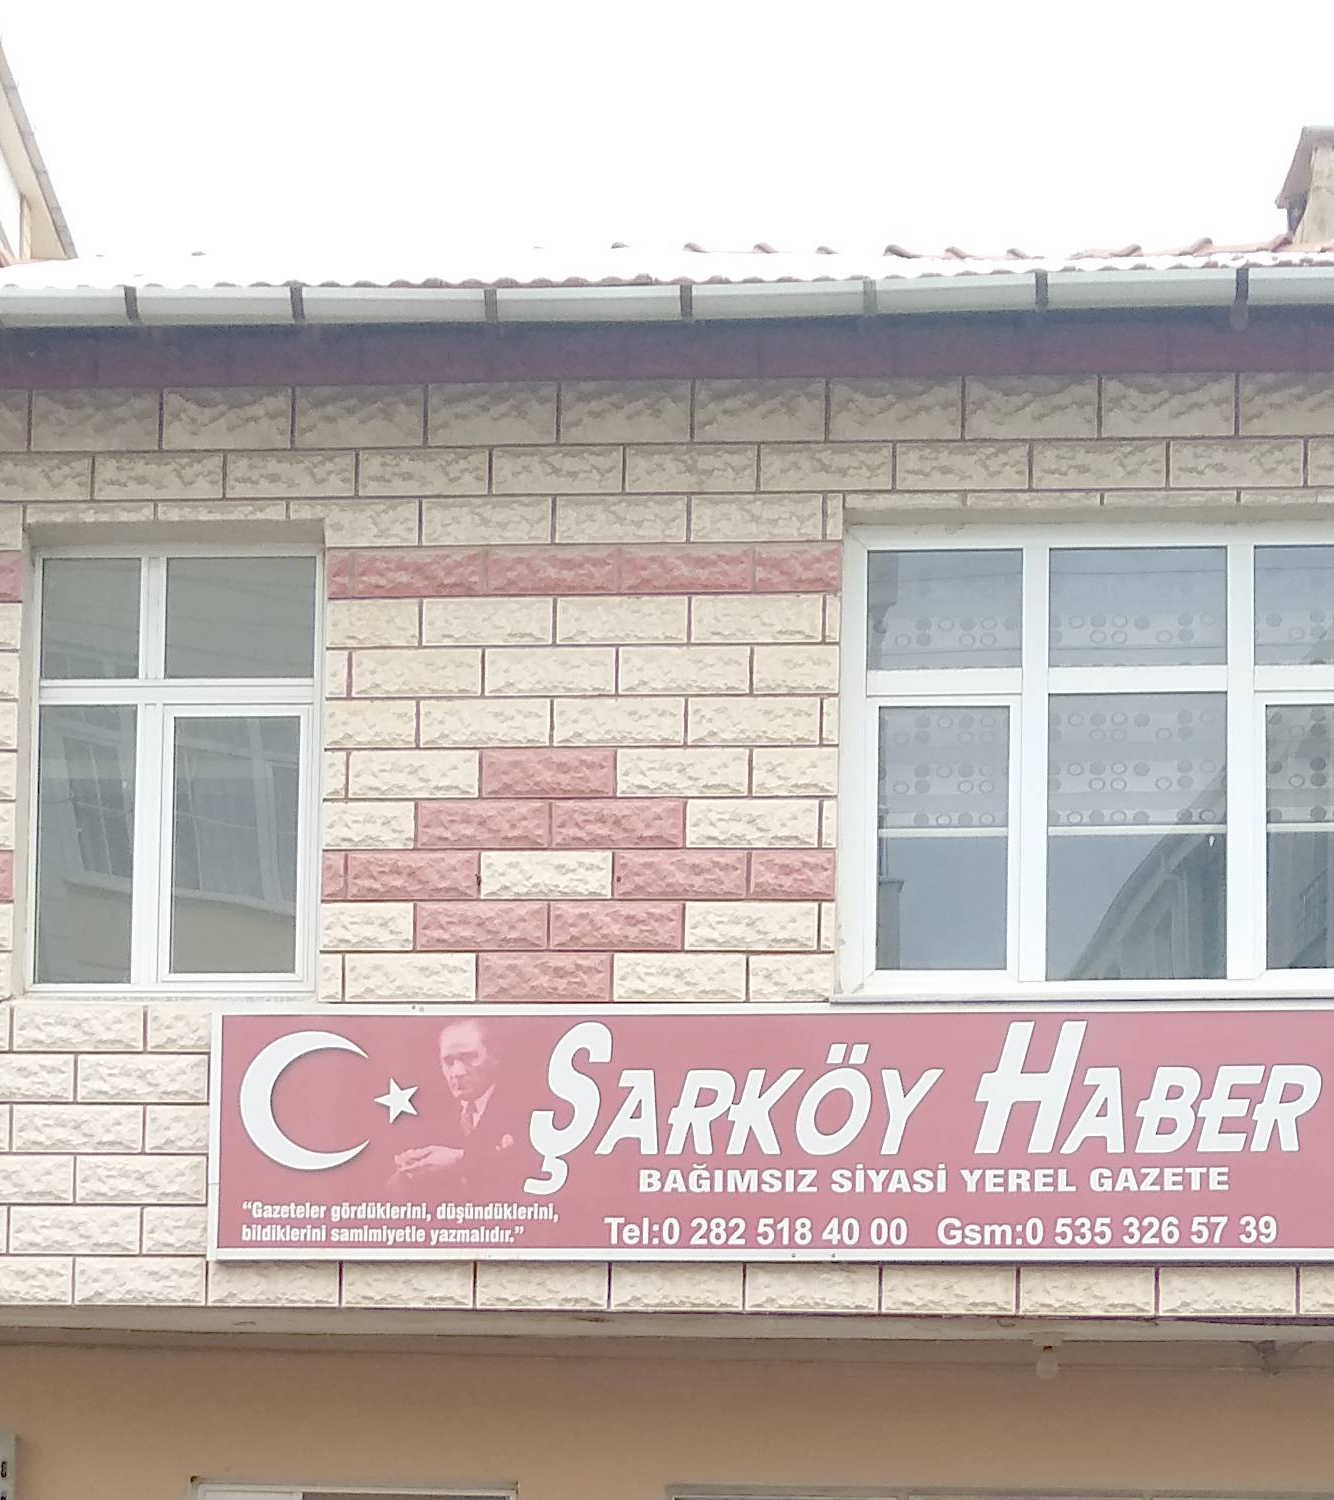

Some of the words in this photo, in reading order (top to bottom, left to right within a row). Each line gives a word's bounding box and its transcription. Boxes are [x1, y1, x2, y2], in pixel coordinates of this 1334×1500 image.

[523, 1021, 945, 1195] ŞARKÖY
[973, 1020, 1323, 1155] HABER
[638, 1163, 819, 1193] BAĞIMSIZ
[830, 1163, 948, 1193] SİYASİ
[960, 1168, 1077, 1193] YEREL
[1089, 1166, 1230, 1192] GAZETE
[331, 1202, 432, 1221] gördüklerini,
[436, 1203, 559, 1223] düşündüklerini,
[242, 1225, 326, 1241] bildiklerini
[330, 1225, 426, 1245] samimiyetle
[604, 1216, 681, 1246] Tel:0
[690, 1217, 747, 1246] 282
[757, 1217, 813, 1246] 518
[822, 1217, 863, 1245] 40
[871, 1217, 908, 1245] 00
[937, 1216, 1044, 1245] Gsm:0
[1053, 1216, 1114, 1245] 535
[1122, 1216, 1181, 1245] 326
[1190, 1216, 1232, 1245] 57
[1239, 1216, 1279, 1245] 39
